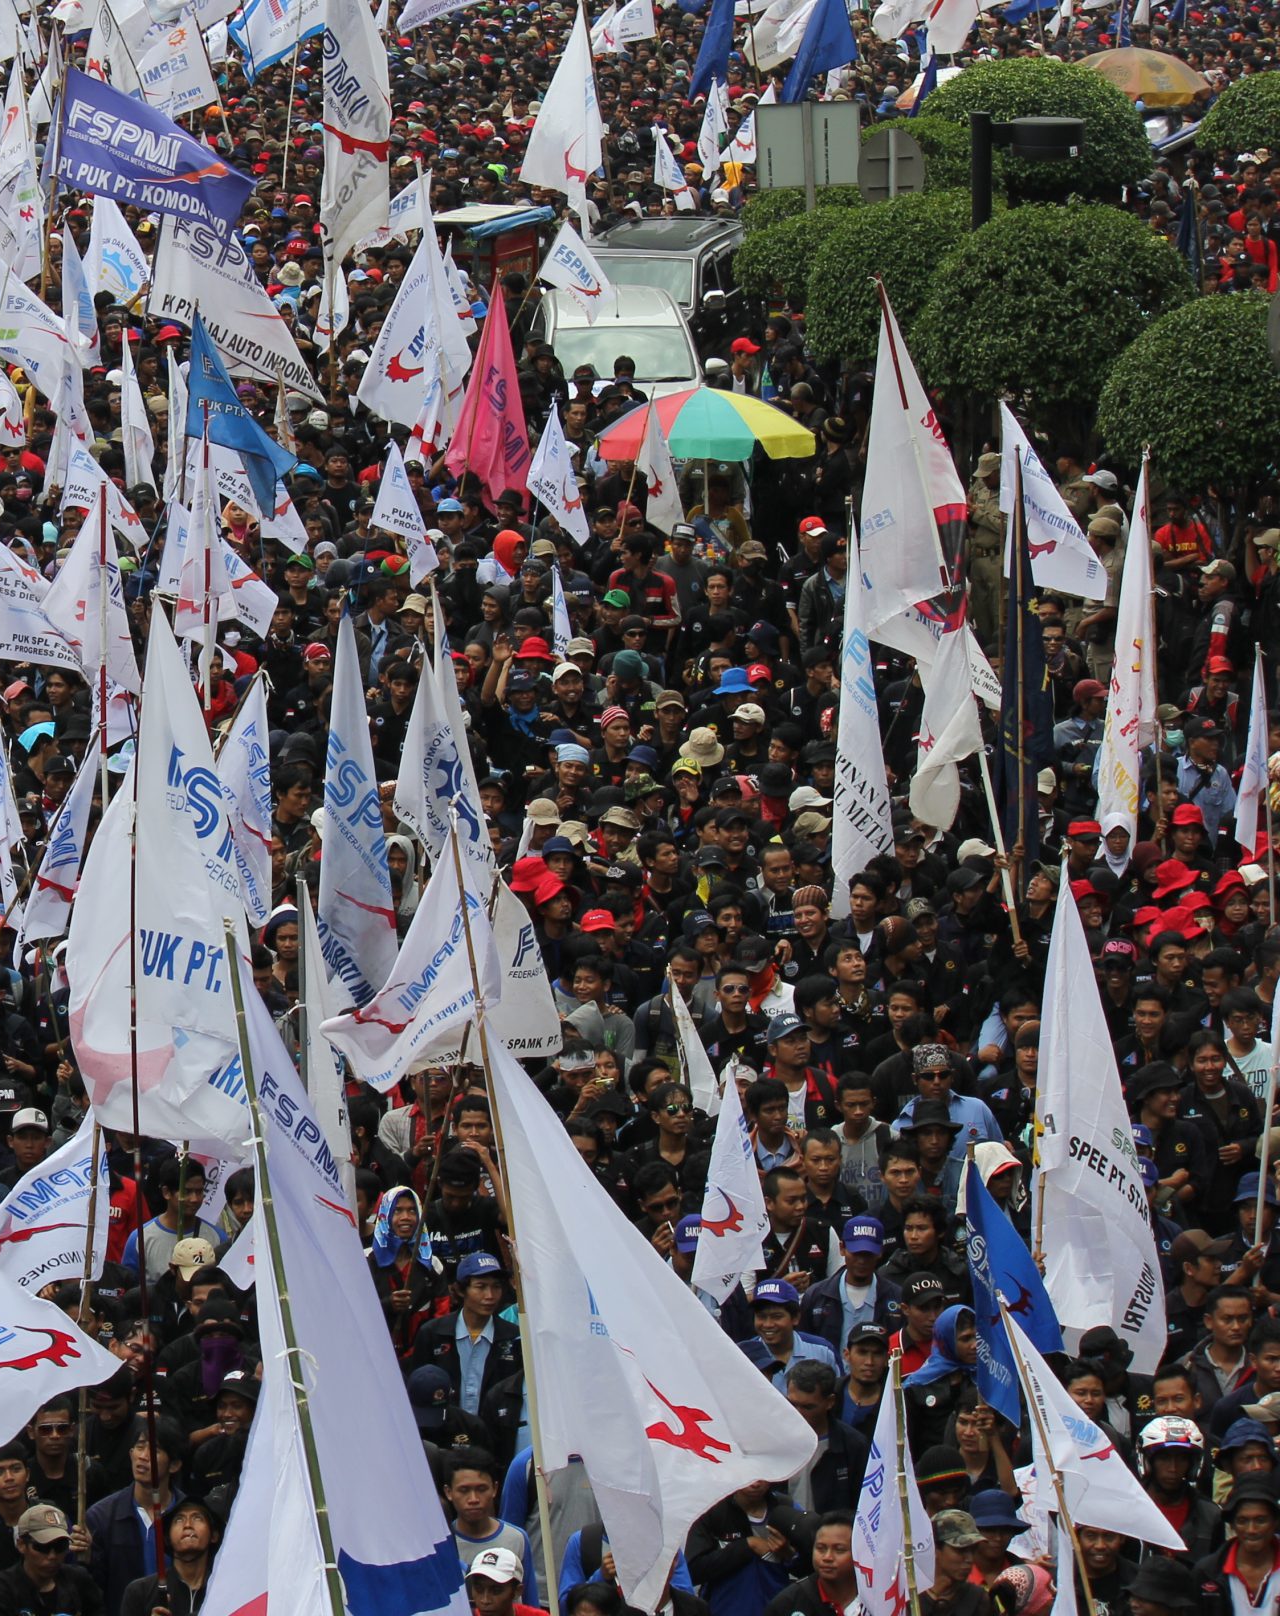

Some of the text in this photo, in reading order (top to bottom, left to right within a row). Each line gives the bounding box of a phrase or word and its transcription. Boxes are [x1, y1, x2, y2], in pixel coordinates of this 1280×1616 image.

[68, 98, 183, 172] FSPMI
[75, 162, 109, 190] PUK
[112, 176, 136, 200] PT.
[553, 243, 594, 290] FSPMI
[176, 300, 322, 396] PT. AUTO INDONES
[198, 398, 222, 411] PUK
[12, 633, 50, 647] PUK SPL
[0, 642, 55, 657] PT. PROGRESS
[183, 940, 223, 995] PT.
[506, 1034, 561, 1050] SPAMK PT.
[1068, 1136, 1107, 1178] SPEE
[1107, 1158, 1126, 1194] PT.
[852, 1225, 877, 1237] SAKURA
[756, 1283, 780, 1295] SAKURA
[911, 1279, 944, 1294] NOAH
